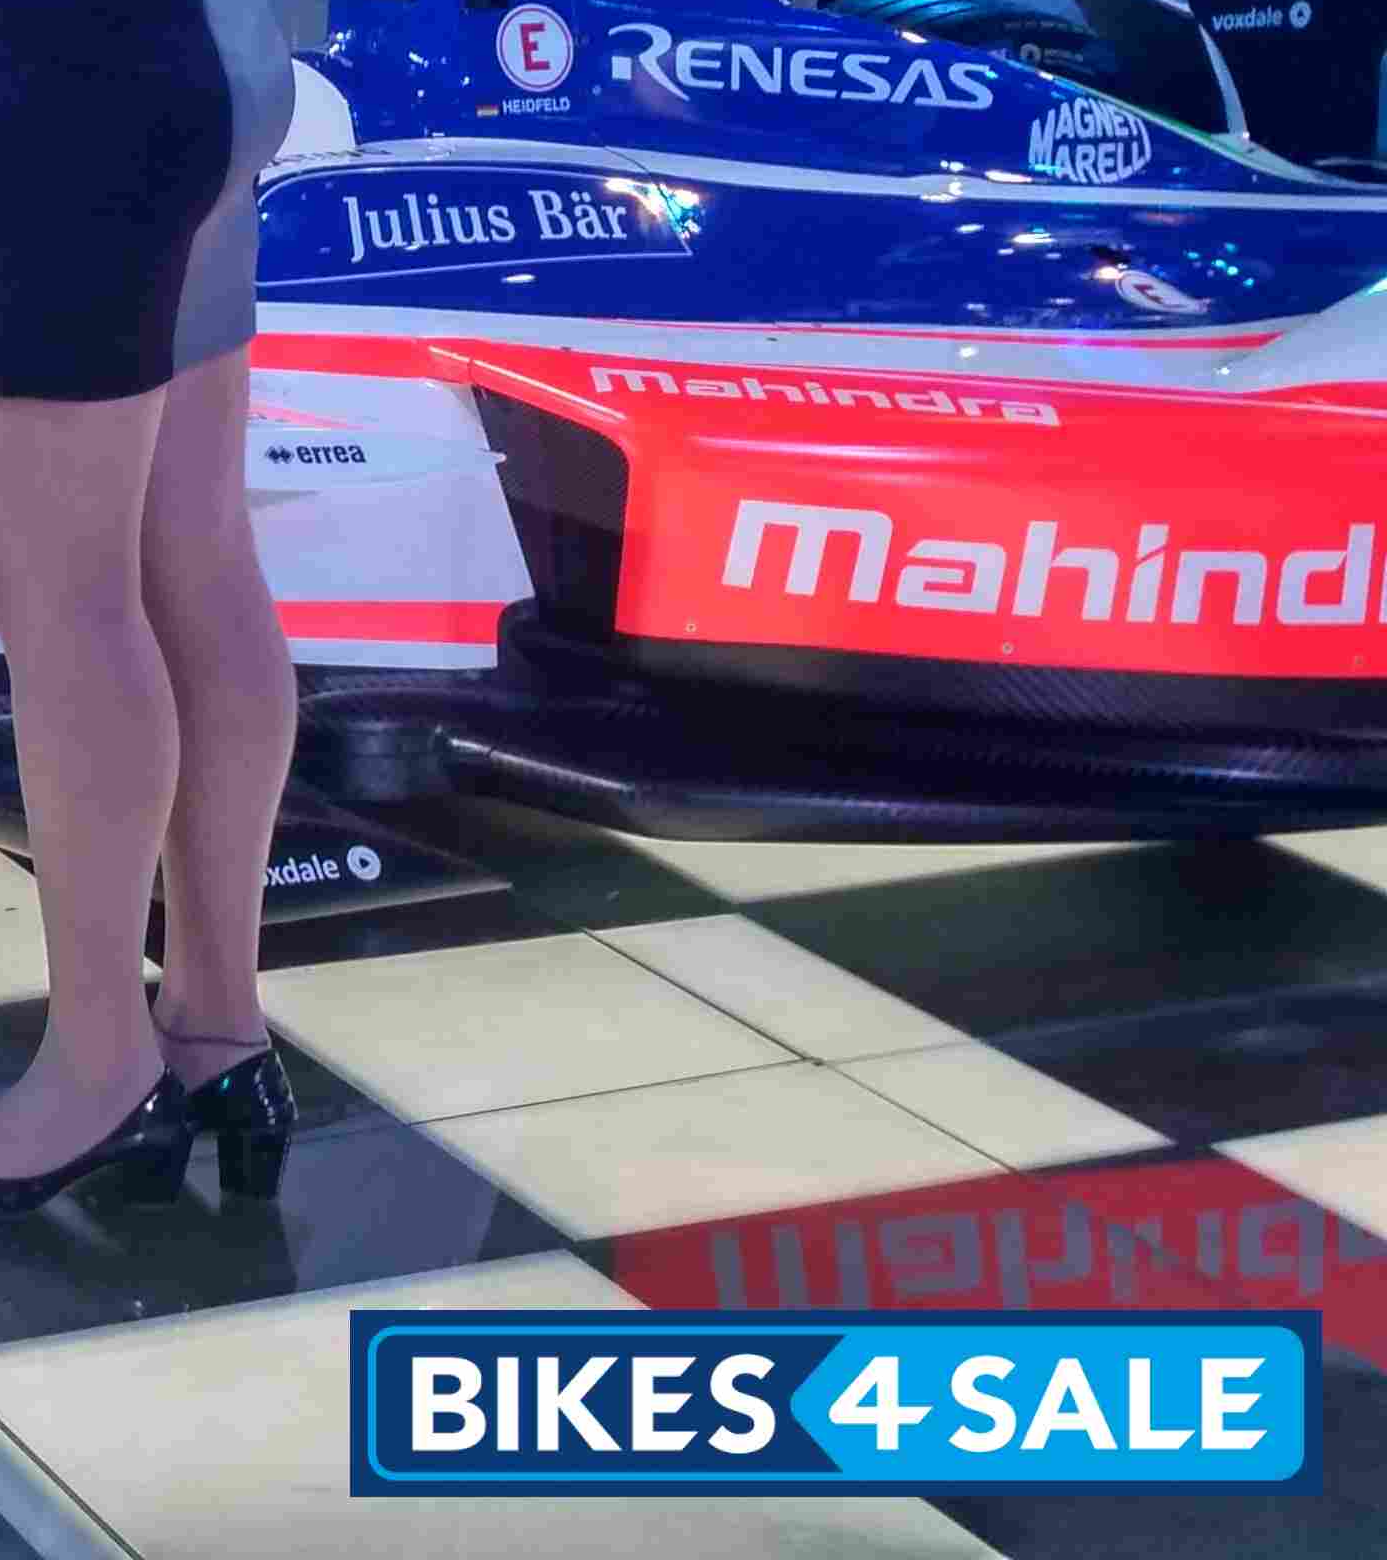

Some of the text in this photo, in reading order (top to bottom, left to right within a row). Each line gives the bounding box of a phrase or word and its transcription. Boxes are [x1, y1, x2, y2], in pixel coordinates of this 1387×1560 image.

[1212, 5, 1283, 32] voxdale
[519, 22, 550, 71] E
[607, 22, 994, 110] RENESAS
[502, 96, 571, 115] HEIDFELD
[342, 189, 627, 263] Julius Bär
[296, 445, 367, 464] errea
